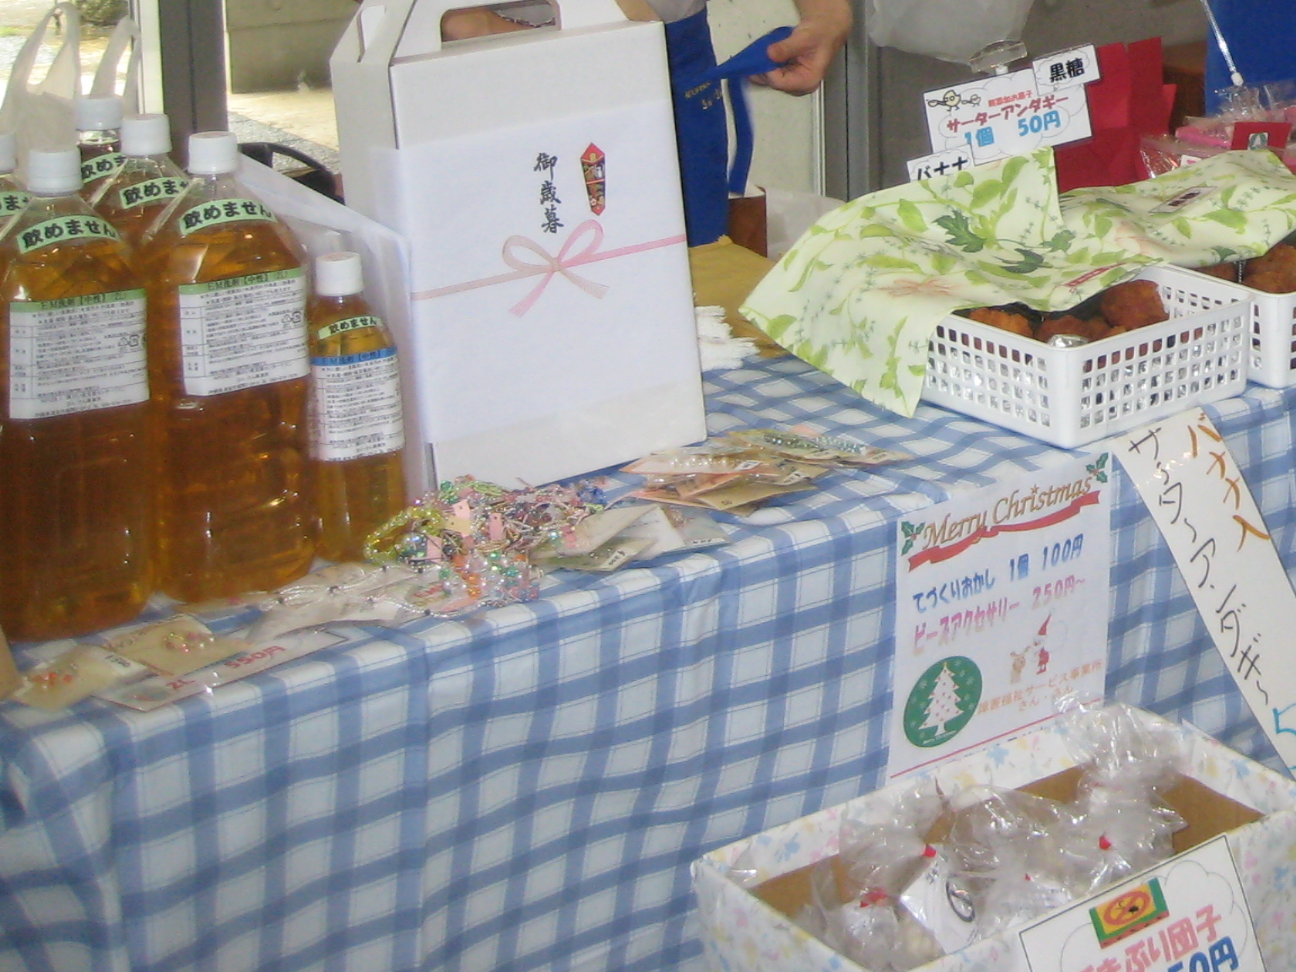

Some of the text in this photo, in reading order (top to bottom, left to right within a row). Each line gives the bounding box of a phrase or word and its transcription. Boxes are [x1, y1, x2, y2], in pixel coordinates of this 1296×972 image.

[1048, 57, 1086, 83] 黒糖
[945, 93, 1070, 133] サーターアンダギー
[963, 109, 1062, 148] 1個 50円
[533, 151, 565, 234] 御歳暮
[22, 215, 118, 249] 飲めません
[182, 200, 273, 231] 飲めません
[328, 316, 379, 334] 飲めません
[1187, 412, 1271, 552] バナナ入
[923, 475, 1092, 550] Merry Christmas
[912, 533, 1084, 614] てづくりおかし 1個 100円
[1079, 904, 1222, 972] きぶり団子
